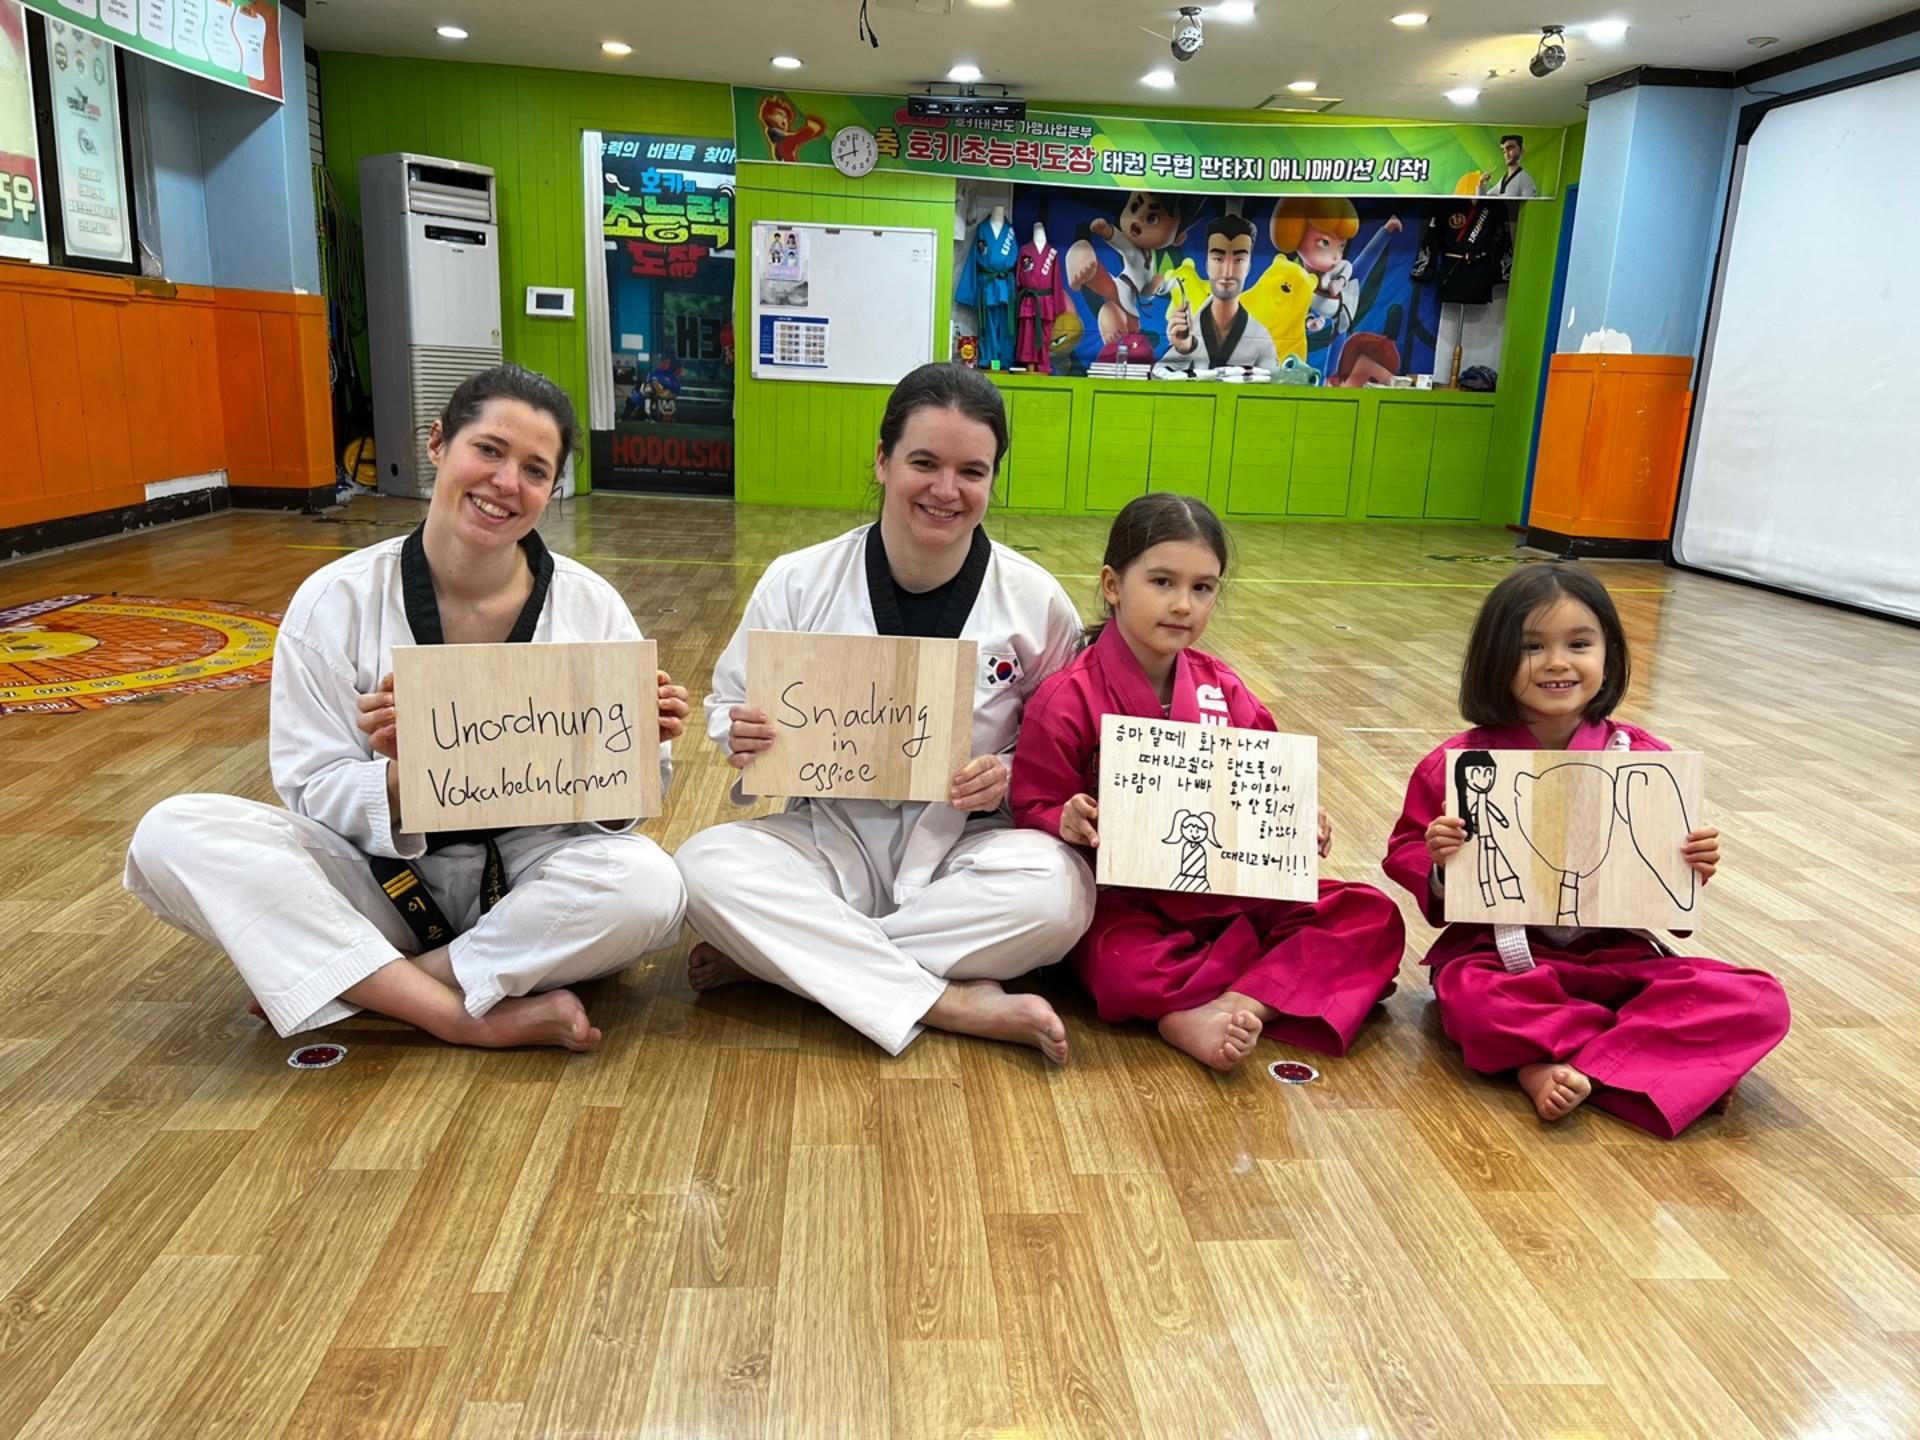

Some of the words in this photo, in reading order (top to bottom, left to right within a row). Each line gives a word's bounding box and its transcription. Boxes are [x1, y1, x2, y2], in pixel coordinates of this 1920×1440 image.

[955, 118, 1014, 133] 호키태권도
[1019, 120, 1092, 138] 가맹사업본부
[647, 143, 697, 162] 비밀을
[905, 129, 1097, 175] 호키초능력도장
[1102, 150, 1146, 176] 태권
[1151, 154, 1193, 179] 무협
[1199, 156, 1264, 180] 판타지
[1378, 158, 1429, 183] 시작!
[640, 167, 697, 194] 호키의
[603, 189, 729, 249] 초능력
[625, 241, 710, 279] 도장
[611, 434, 732, 470] HODOLSKI
[431, 696, 633, 752] Unordnung
[777, 681, 932, 758] Snacking
[832, 732, 857, 755] in
[1114, 772, 1161, 794] 하람이
[1177, 777, 1212, 793] 나빠
